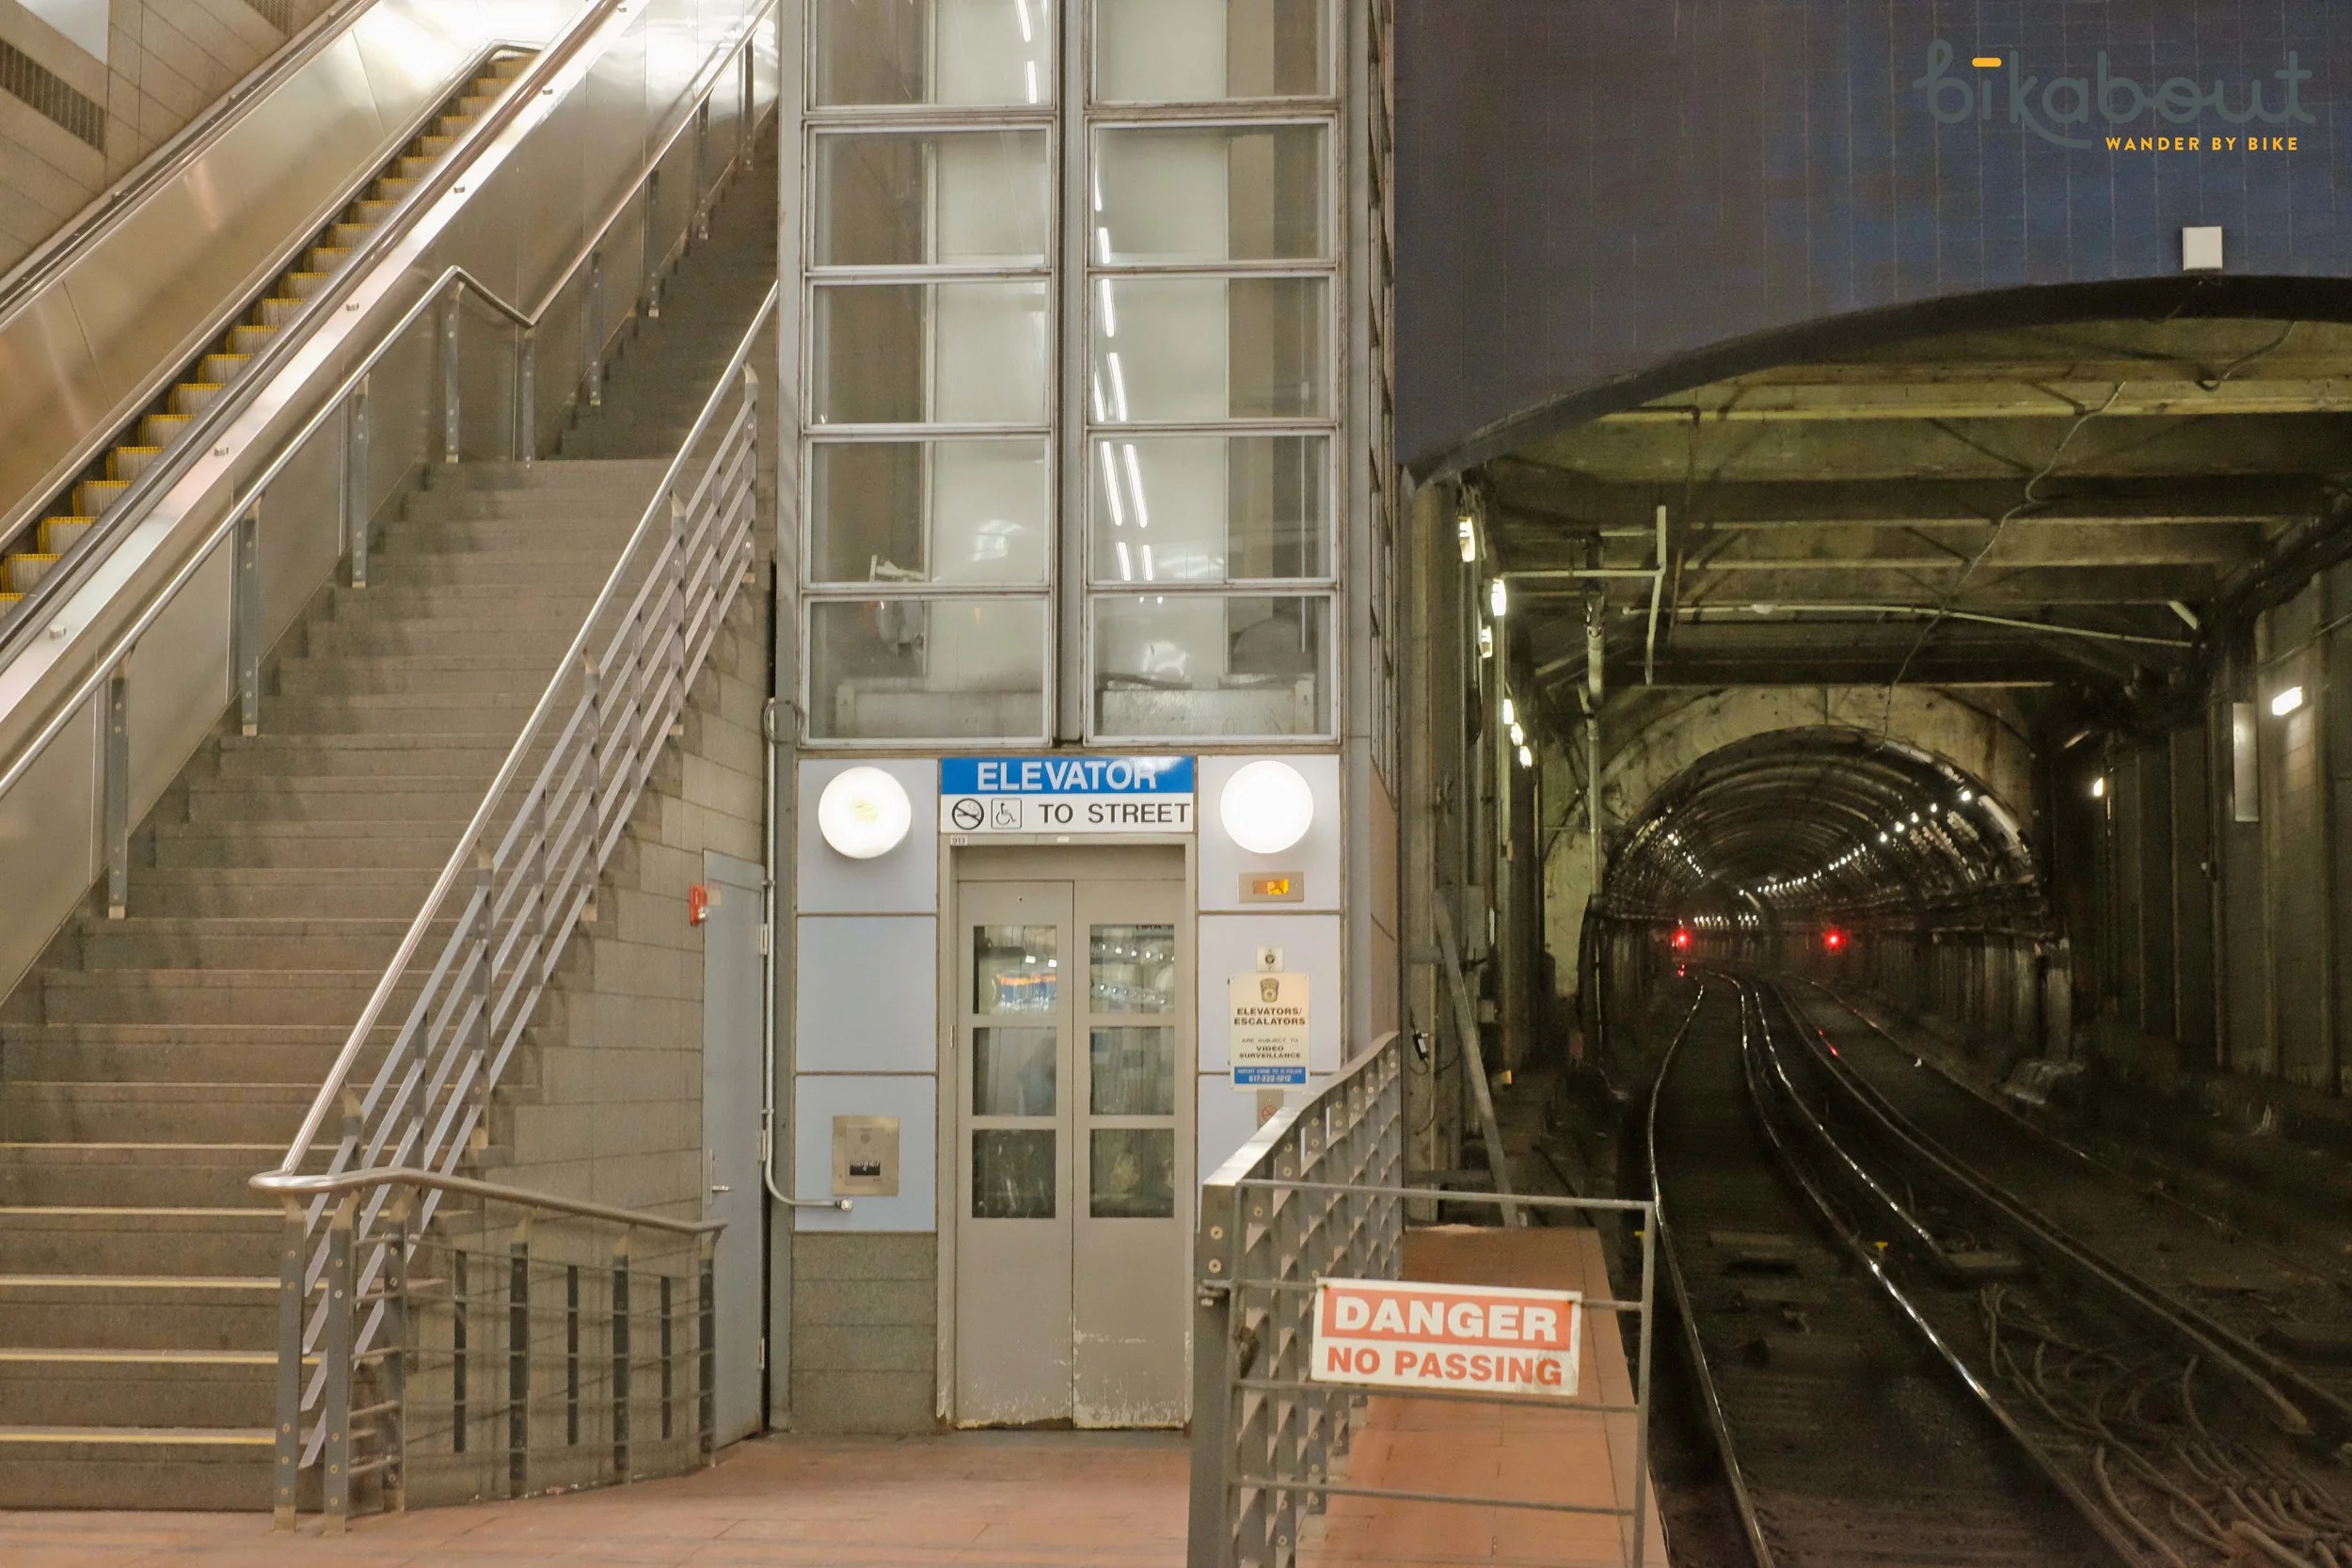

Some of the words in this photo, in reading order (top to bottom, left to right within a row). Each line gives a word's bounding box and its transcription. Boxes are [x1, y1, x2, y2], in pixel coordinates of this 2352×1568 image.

[977, 760, 1157, 791] ELEVATOR
[1039, 803, 1073, 824] TO
[1088, 803, 1191, 824] STREET
[1233, 1017, 1306, 1025] ESCALATORS
[1334, 1295, 1558, 1342] DANGER
[1327, 1346, 1380, 1374] NO
[1394, 1350, 1562, 1386] PASSING
